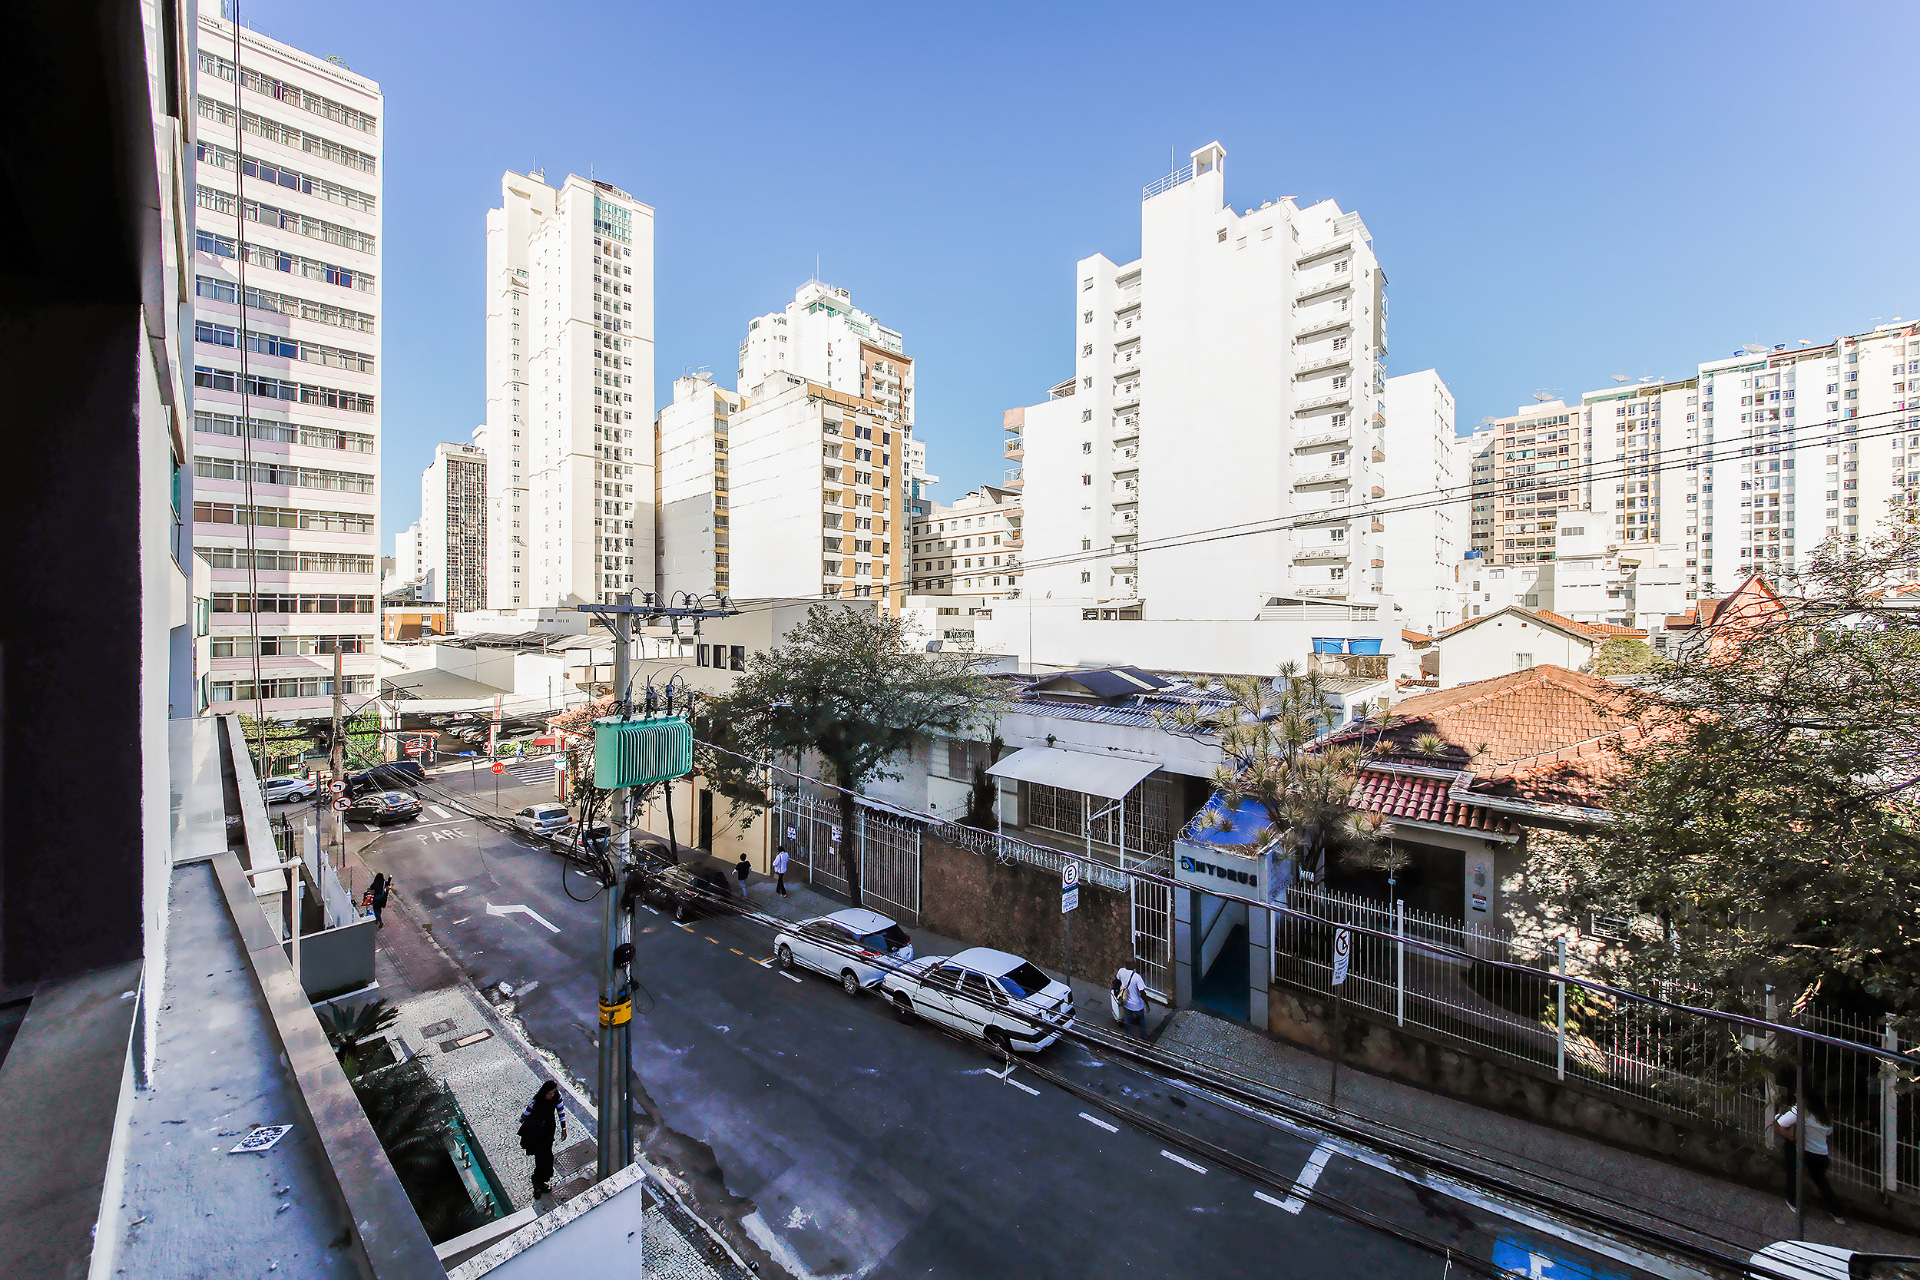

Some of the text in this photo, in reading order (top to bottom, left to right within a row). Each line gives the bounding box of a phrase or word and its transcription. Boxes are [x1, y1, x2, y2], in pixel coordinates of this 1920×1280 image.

[416, 827, 471, 846] PARE
[1067, 869, 1073, 881] E
[1195, 860, 1258, 887] HYDRUS
